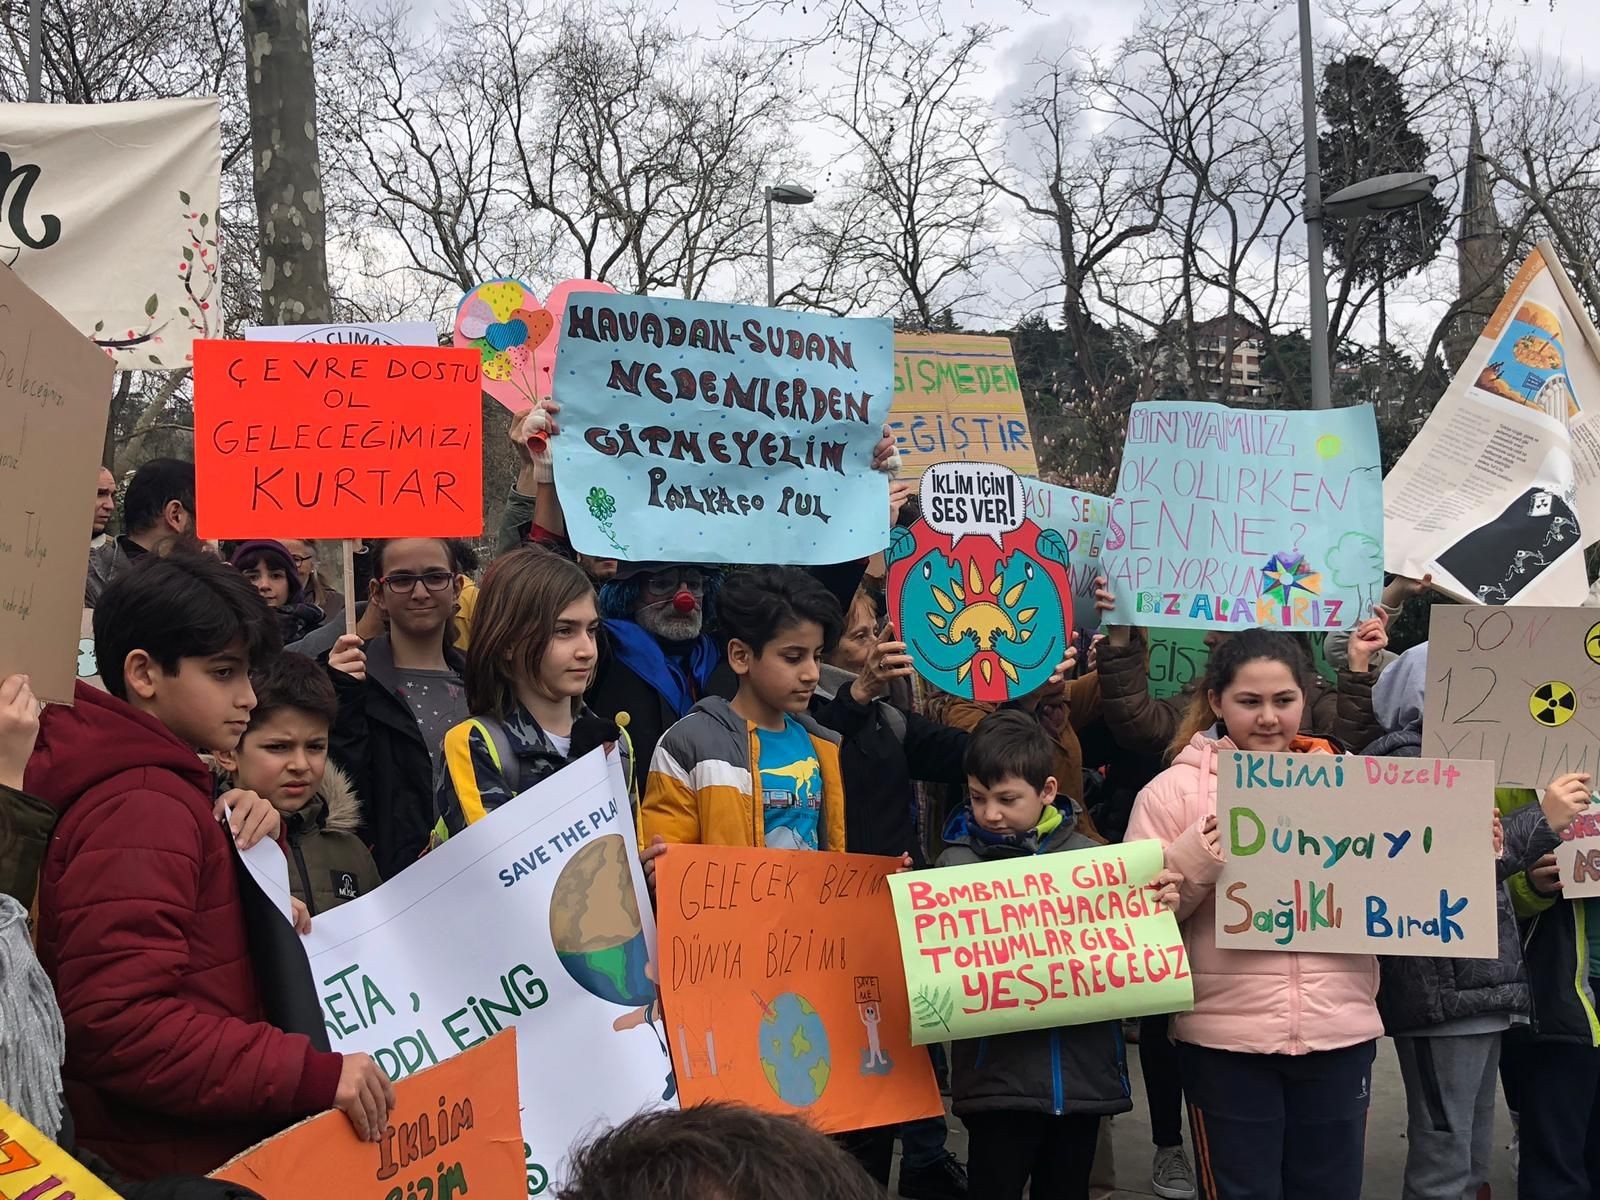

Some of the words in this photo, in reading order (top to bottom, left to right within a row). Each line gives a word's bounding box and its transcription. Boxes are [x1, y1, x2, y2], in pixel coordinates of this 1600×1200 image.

[567, 304, 857, 372] HAVADAN-SUDAN
[228, 357, 368, 388] ÇEVRE
[387, 359, 479, 383] DOSTU
[324, 389, 371, 408] OL
[606, 360, 874, 424] NEDENLERDEN
[213, 420, 472, 454] GELECEĞİMİZİ
[252, 466, 465, 512] KURTAR
[648, 467, 764, 516] PALYAÇO
[777, 486, 831, 524] PUL
[932, 469, 973, 495] İKLİM
[977, 471, 1005, 498] İÇİN
[1173, 459, 1351, 512] OLURKEN
[932, 497, 967, 523] SES
[1106, 498, 1195, 551] SEN
[1210, 510, 1276, 556] NE
[1101, 555, 1263, 598] YAPIYORSUN
[1457, 609, 1552, 652] SON
[1438, 666, 1500, 724] 12
[1365, 757, 1461, 788] Düzelt
[498, 845, 552, 888] SAVE
[548, 819, 591, 853] THE
[679, 860, 800, 920] GELECEK
[908, 872, 1060, 911] BOMBALAR
[1072, 856, 1128, 889] GİBİ
[672, 933, 742, 991] DÜNYA
[766, 929, 846, 978] BİZİM!
[920, 928, 1077, 974] TOHUMLAR
[1080, 923, 1136, 951] GİBİ
[856, 977, 876, 990] SAVE
[961, 943, 1189, 1015] YEŞERECEĞİZ
